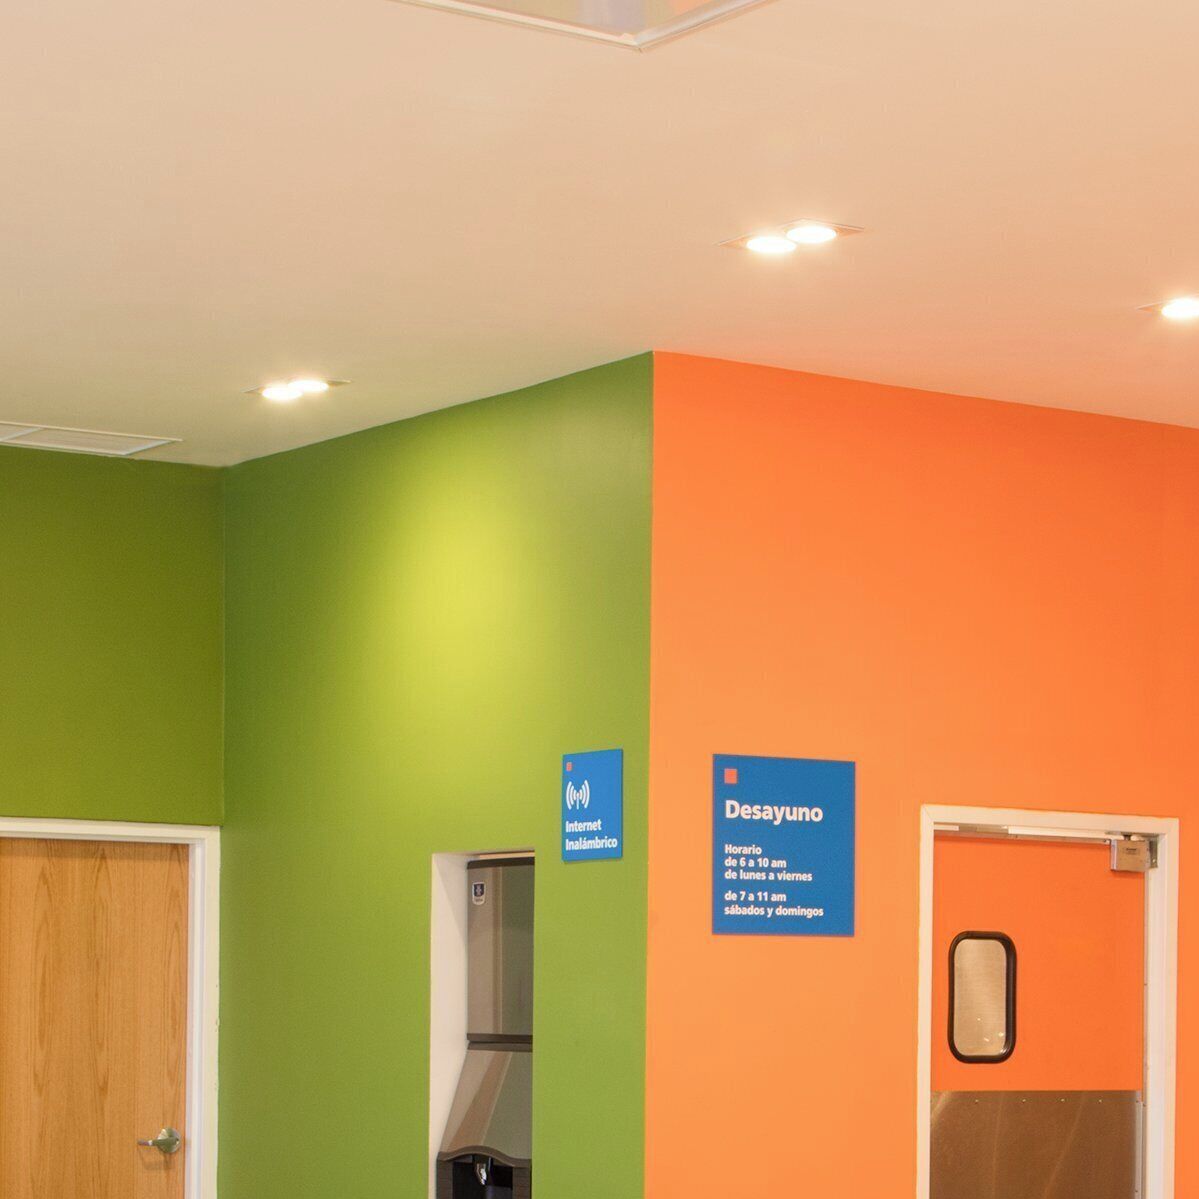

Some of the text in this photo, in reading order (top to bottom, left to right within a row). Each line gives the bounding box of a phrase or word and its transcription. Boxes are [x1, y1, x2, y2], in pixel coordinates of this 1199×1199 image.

[725, 799, 824, 826] Desayuno
[565, 819, 602, 833] Internet
[565, 836, 618, 851] Inalámbrico
[724, 844, 762, 855] Horario
[724, 856, 787, 869] de 6 a 10 am
[724, 868, 813, 882] de lunes a viernes
[724, 890, 787, 902] de 7 a 11 am
[724, 904, 824, 918] sábados y domingos
